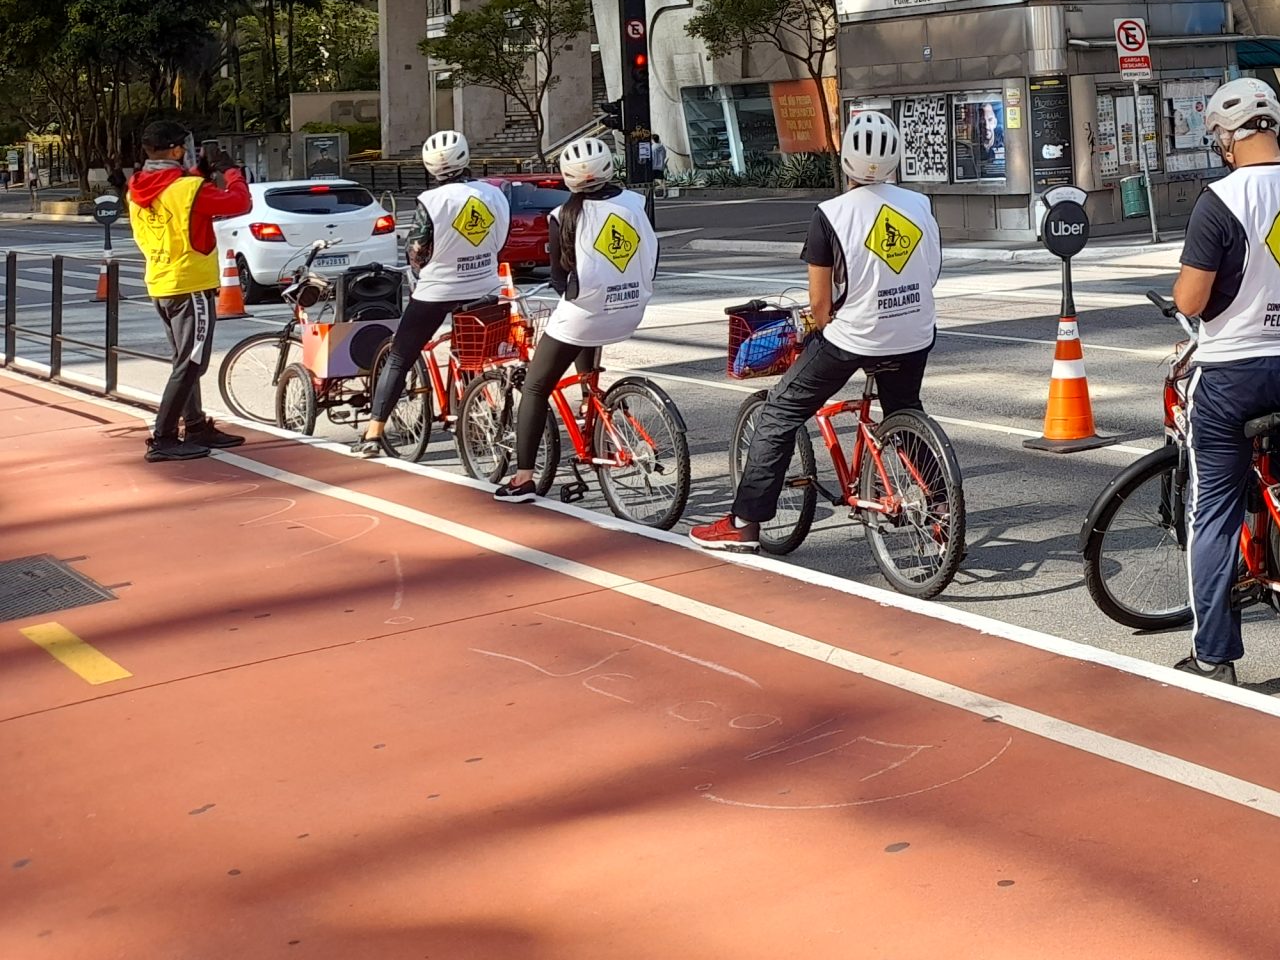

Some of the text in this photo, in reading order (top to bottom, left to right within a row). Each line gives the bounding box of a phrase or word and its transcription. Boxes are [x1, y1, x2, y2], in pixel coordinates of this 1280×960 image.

[331, 100, 380, 123] FC
[97, 209, 117, 217] Uber
[1051, 221, 1085, 236] Uber
[457, 258, 491, 272] PEDALANDO
[605, 289, 640, 303] PEDALANDO
[878, 286, 898, 298] CONHEÇA
[898, 284, 906, 295] SÃO
[878, 292, 920, 310] PEDALANDO
